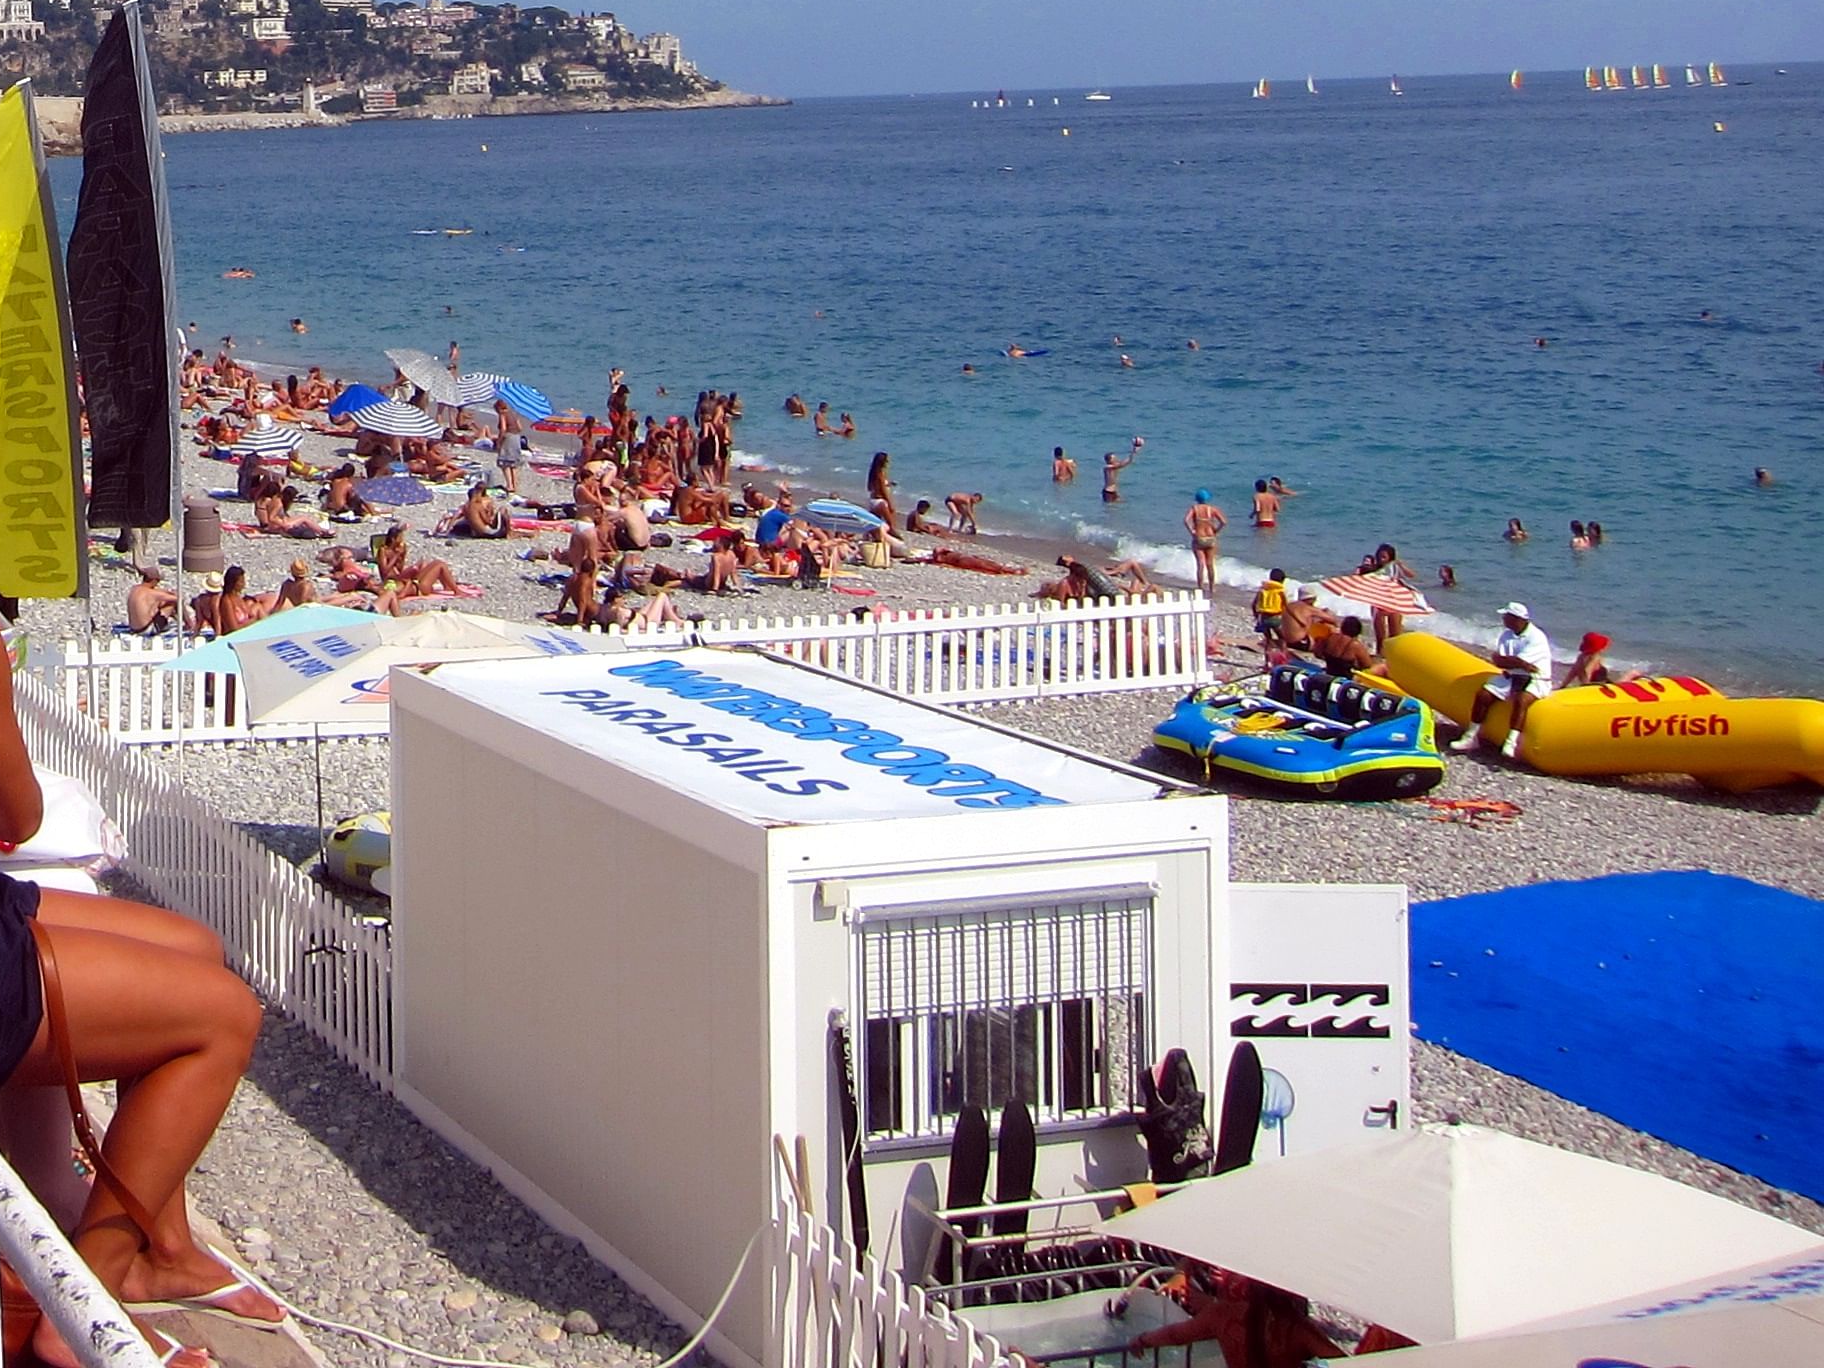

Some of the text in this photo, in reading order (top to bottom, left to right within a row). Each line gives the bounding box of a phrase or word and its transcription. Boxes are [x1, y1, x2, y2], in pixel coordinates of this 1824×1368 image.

[538, 689, 850, 796] PARASAILS
[608, 660, 1071, 809] WATERSPORTS
[1610, 714, 1729, 738] Flyfish
